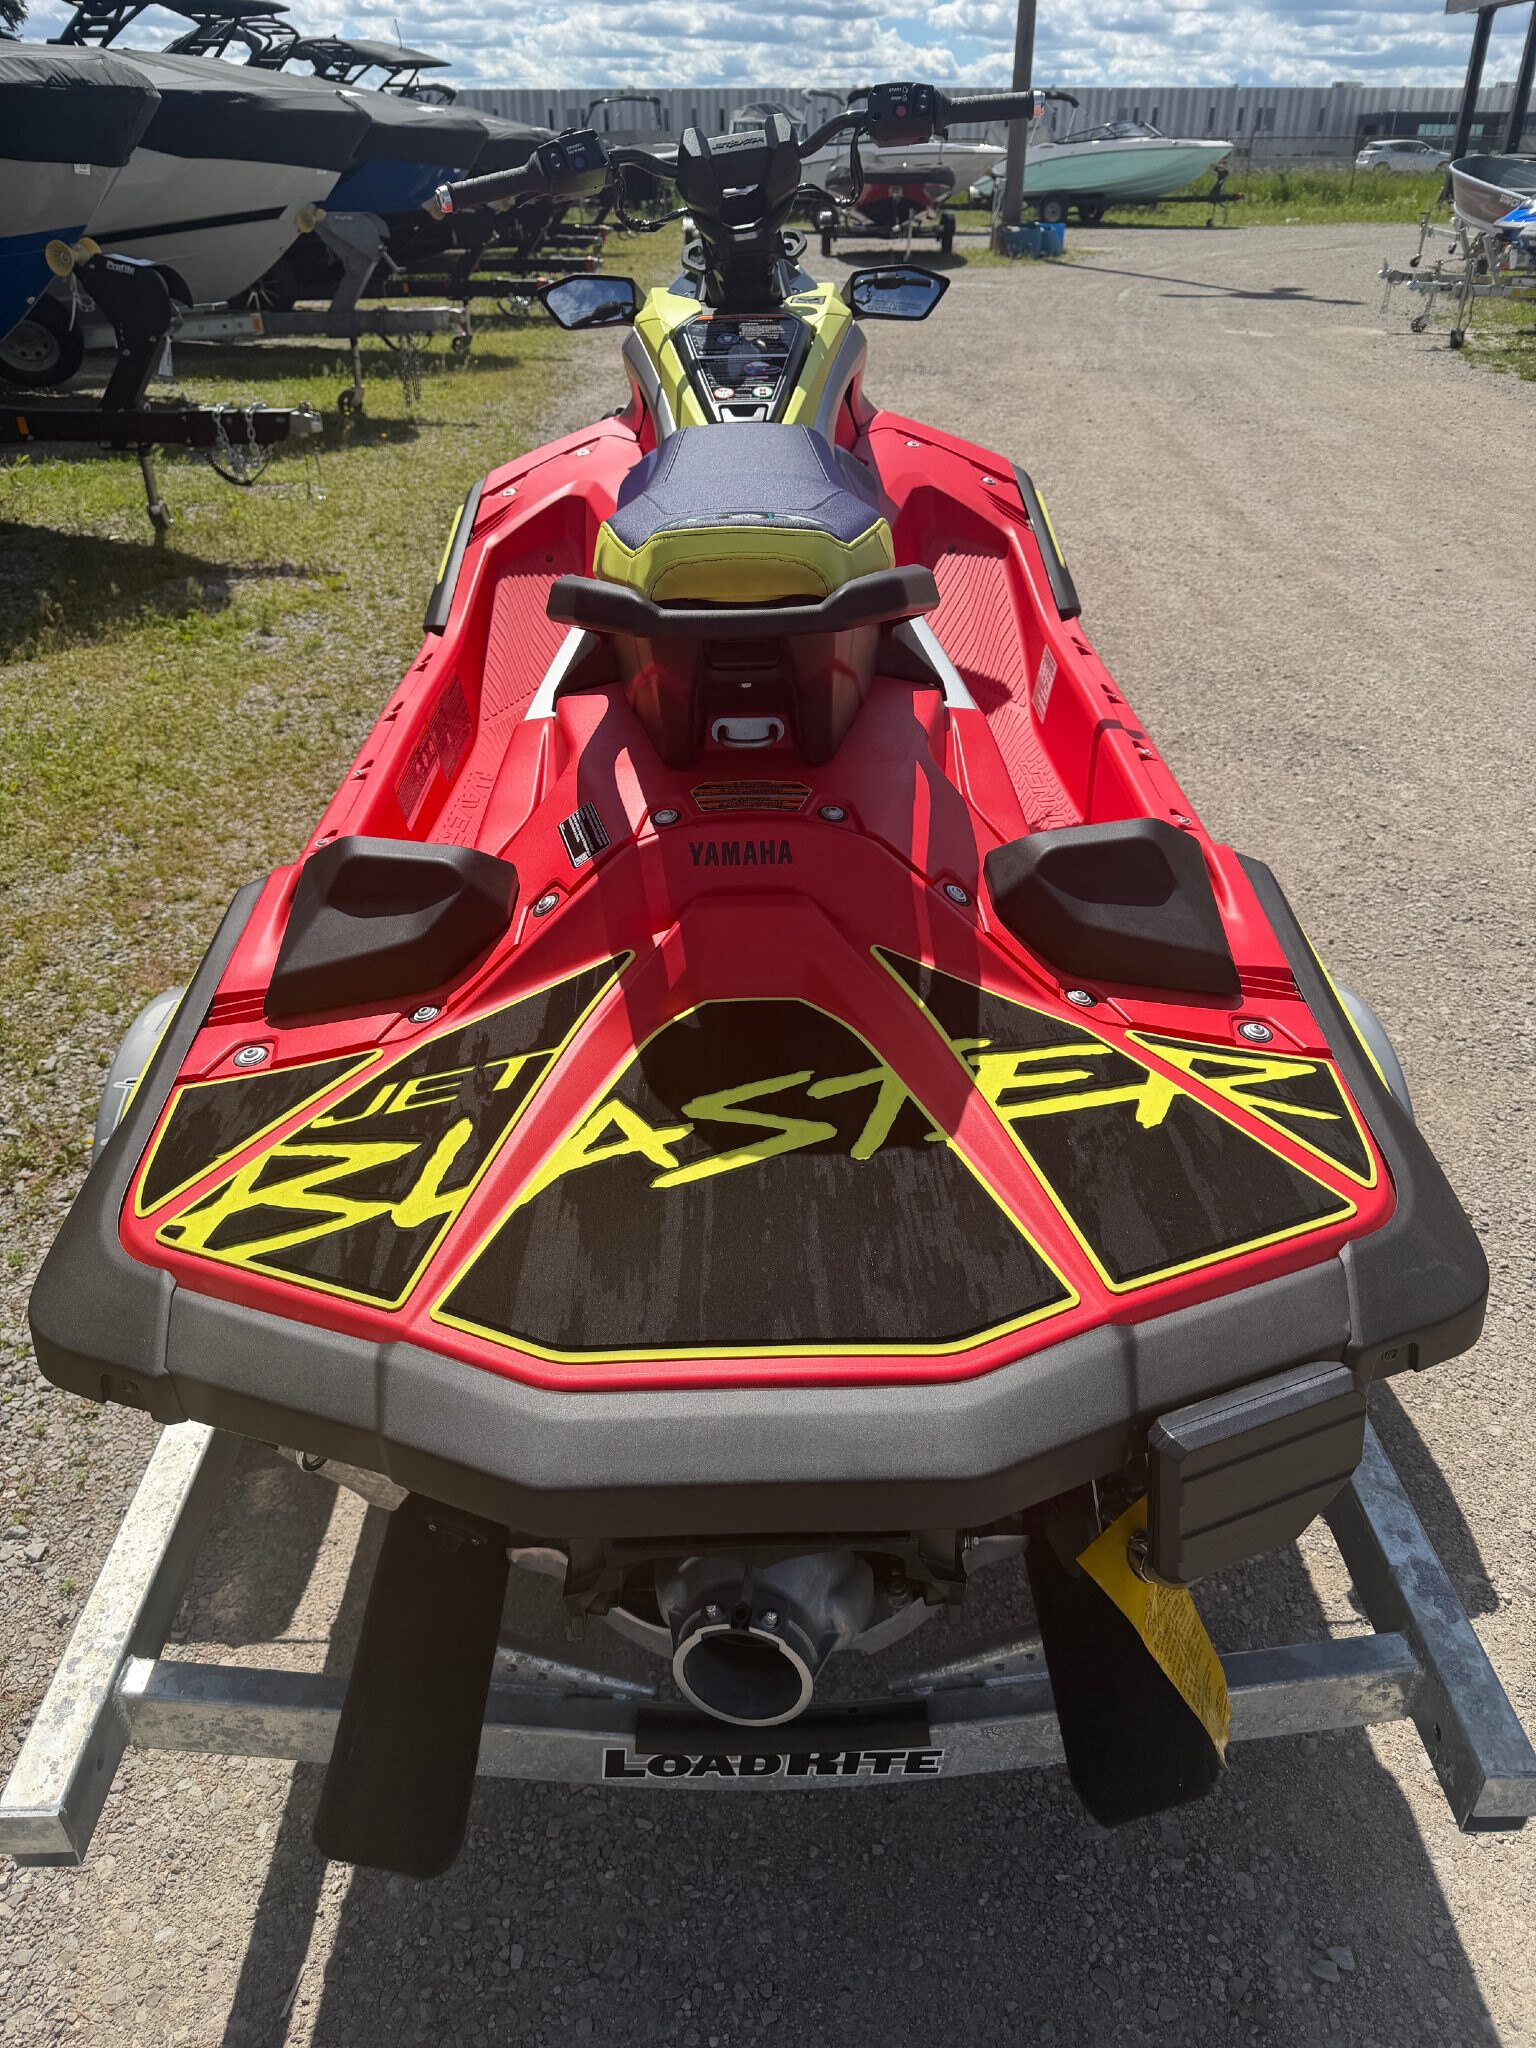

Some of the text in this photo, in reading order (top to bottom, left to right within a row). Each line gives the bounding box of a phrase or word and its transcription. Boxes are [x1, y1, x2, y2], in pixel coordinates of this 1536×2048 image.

[688, 840, 793, 866] YAMAHA
[310, 1048, 560, 1129] JET
[157, 1031, 1343, 1261] BLASTER
